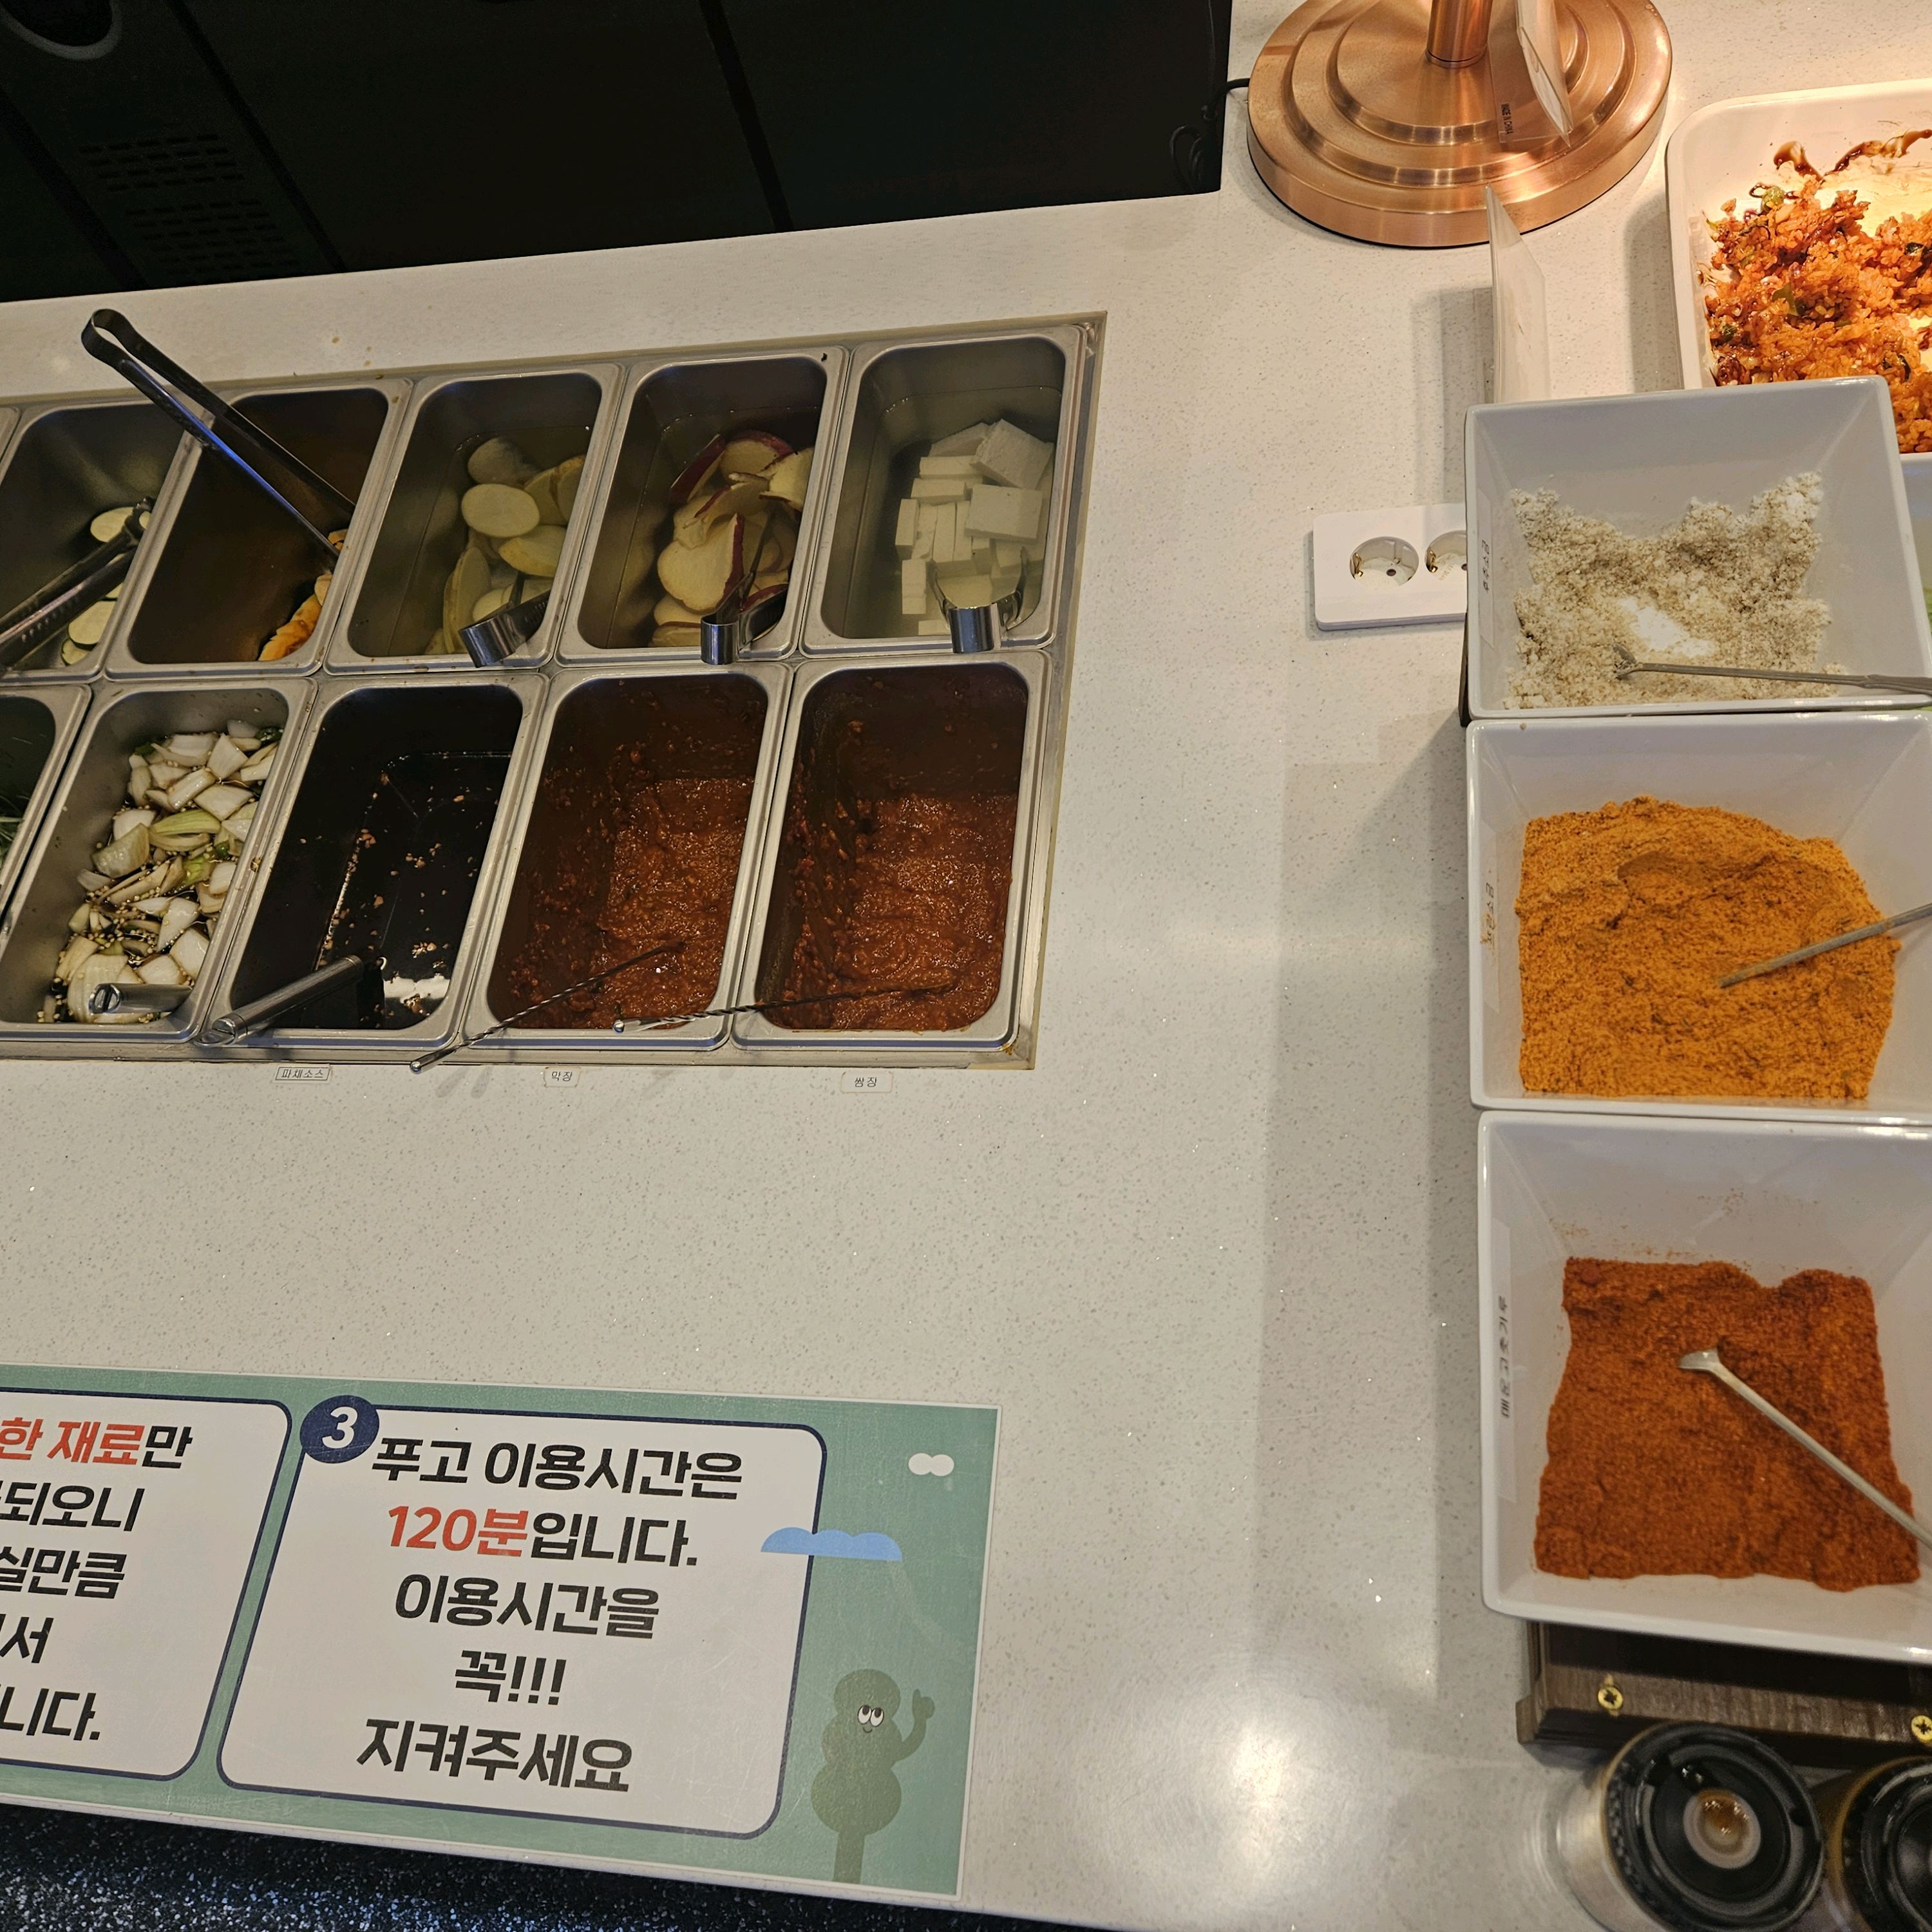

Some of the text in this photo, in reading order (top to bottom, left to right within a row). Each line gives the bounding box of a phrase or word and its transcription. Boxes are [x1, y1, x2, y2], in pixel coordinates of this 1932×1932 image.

[281, 1069, 323, 1079] 파채소스
[551, 1071, 573, 1082] 막장
[855, 1077, 877, 1087] 쌈장
[0, 1417, 193, 1469] 한 재료만
[322, 1406, 358, 1449] 3
[372, 1437, 743, 1500] 푸고 이용시간은
[0, 1480, 146, 1532] 되오니
[387, 1506, 698, 1567] 120분입니다.
[0, 1546, 128, 1599] 실만큼
[395, 1574, 660, 1639] 이용시간을
[0, 1613, 54, 1663] 서
[455, 1650, 567, 1706] 꼭!!!
[0, 1684, 100, 1741] 니다.
[356, 1718, 633, 1792] 지켜주세요
